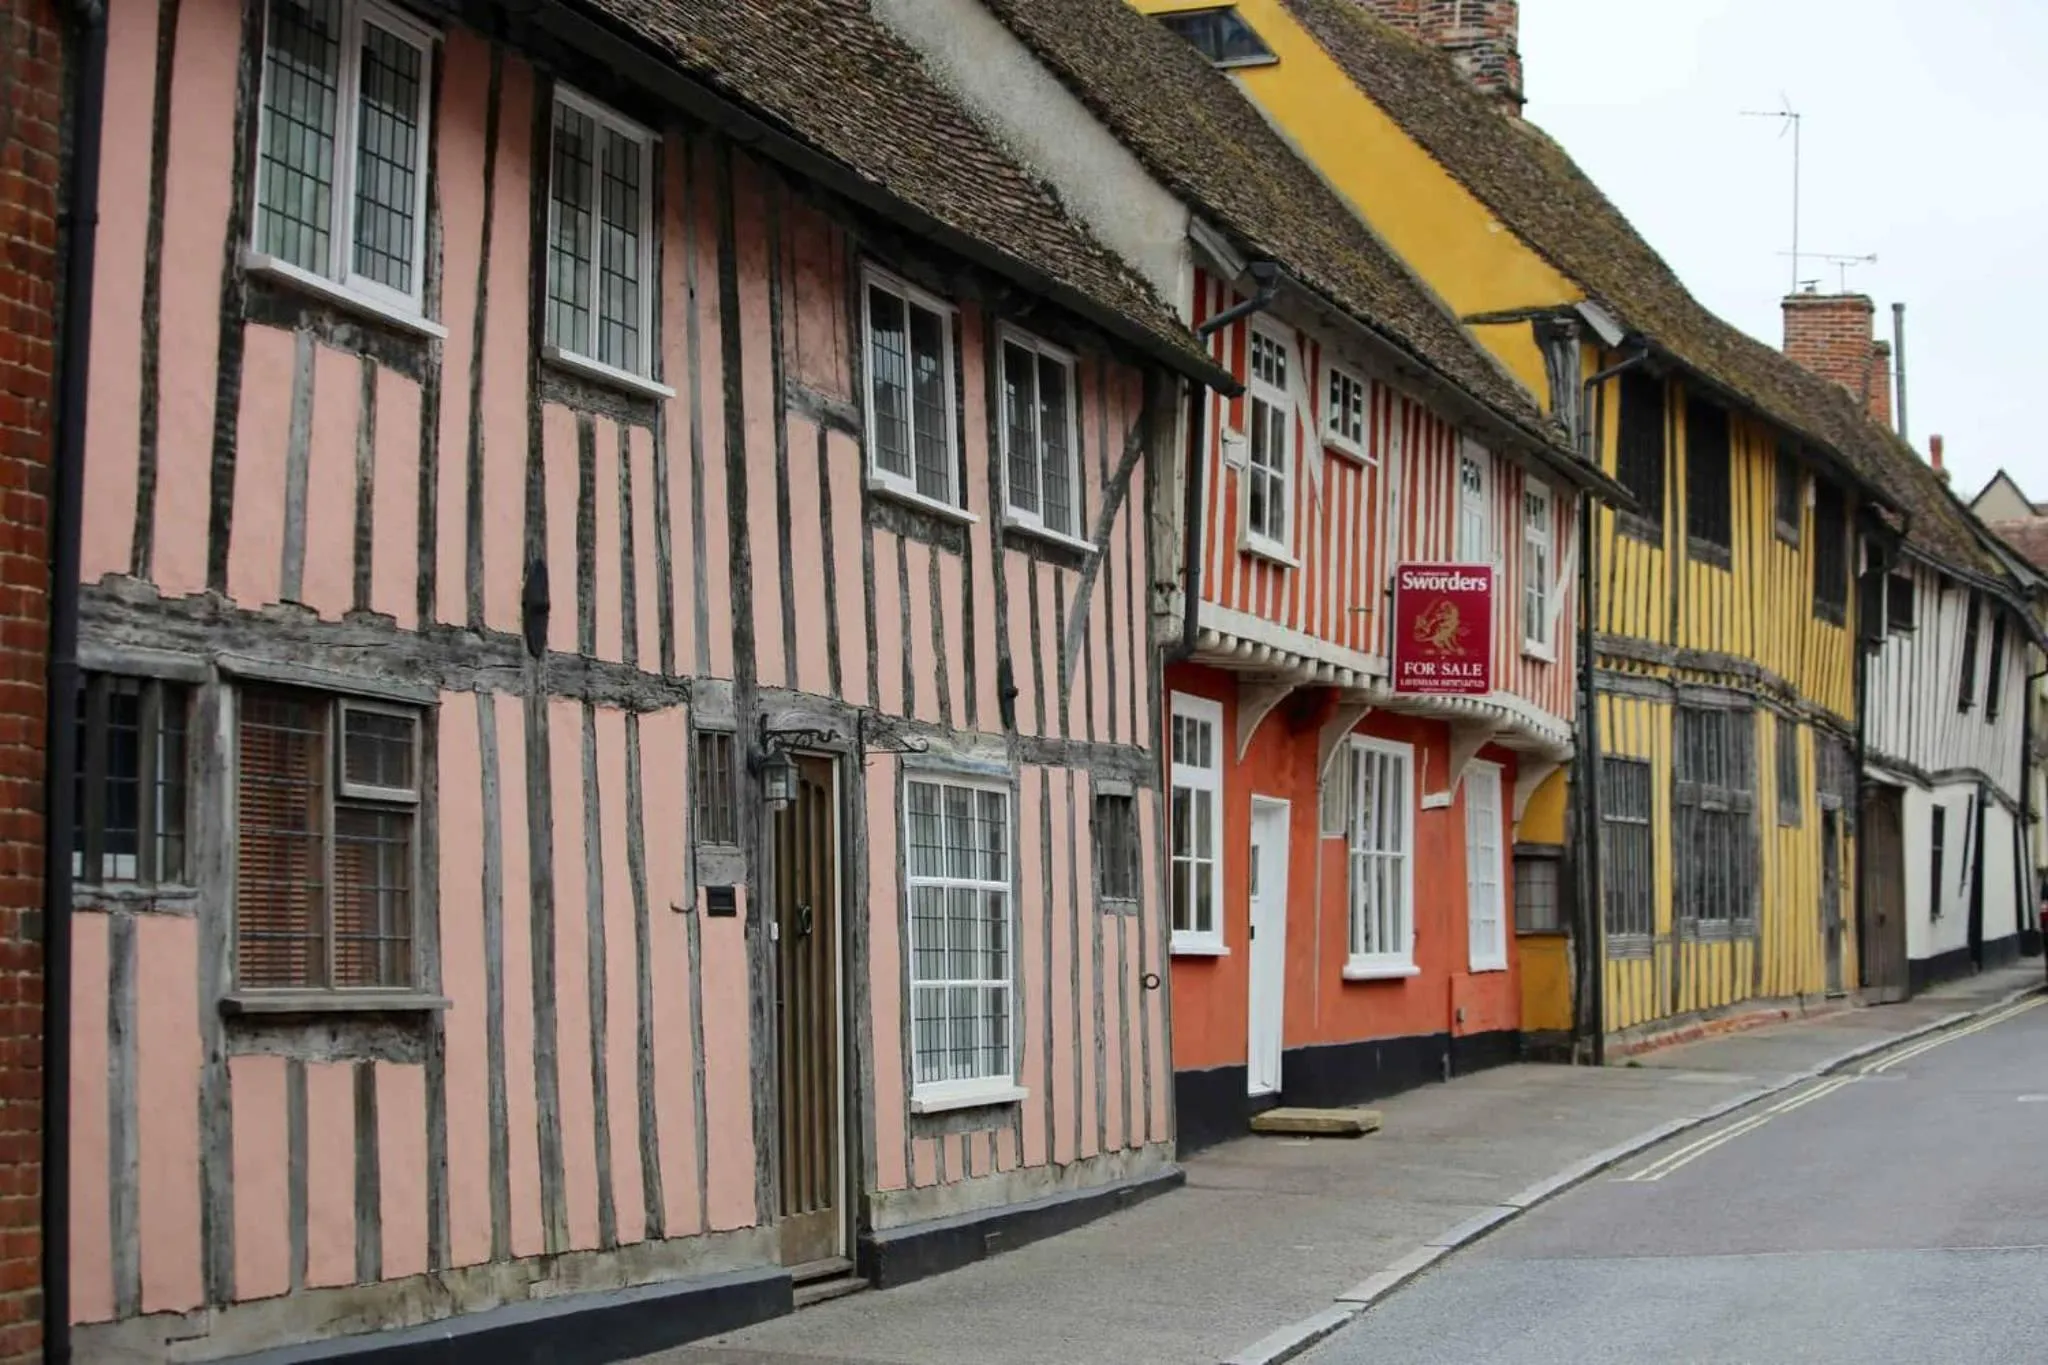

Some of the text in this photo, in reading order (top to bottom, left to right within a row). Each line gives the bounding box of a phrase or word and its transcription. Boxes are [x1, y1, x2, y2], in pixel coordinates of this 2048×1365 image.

[1402, 571, 1487, 591] Sworders
[1404, 662, 1482, 676] FOR SALE
